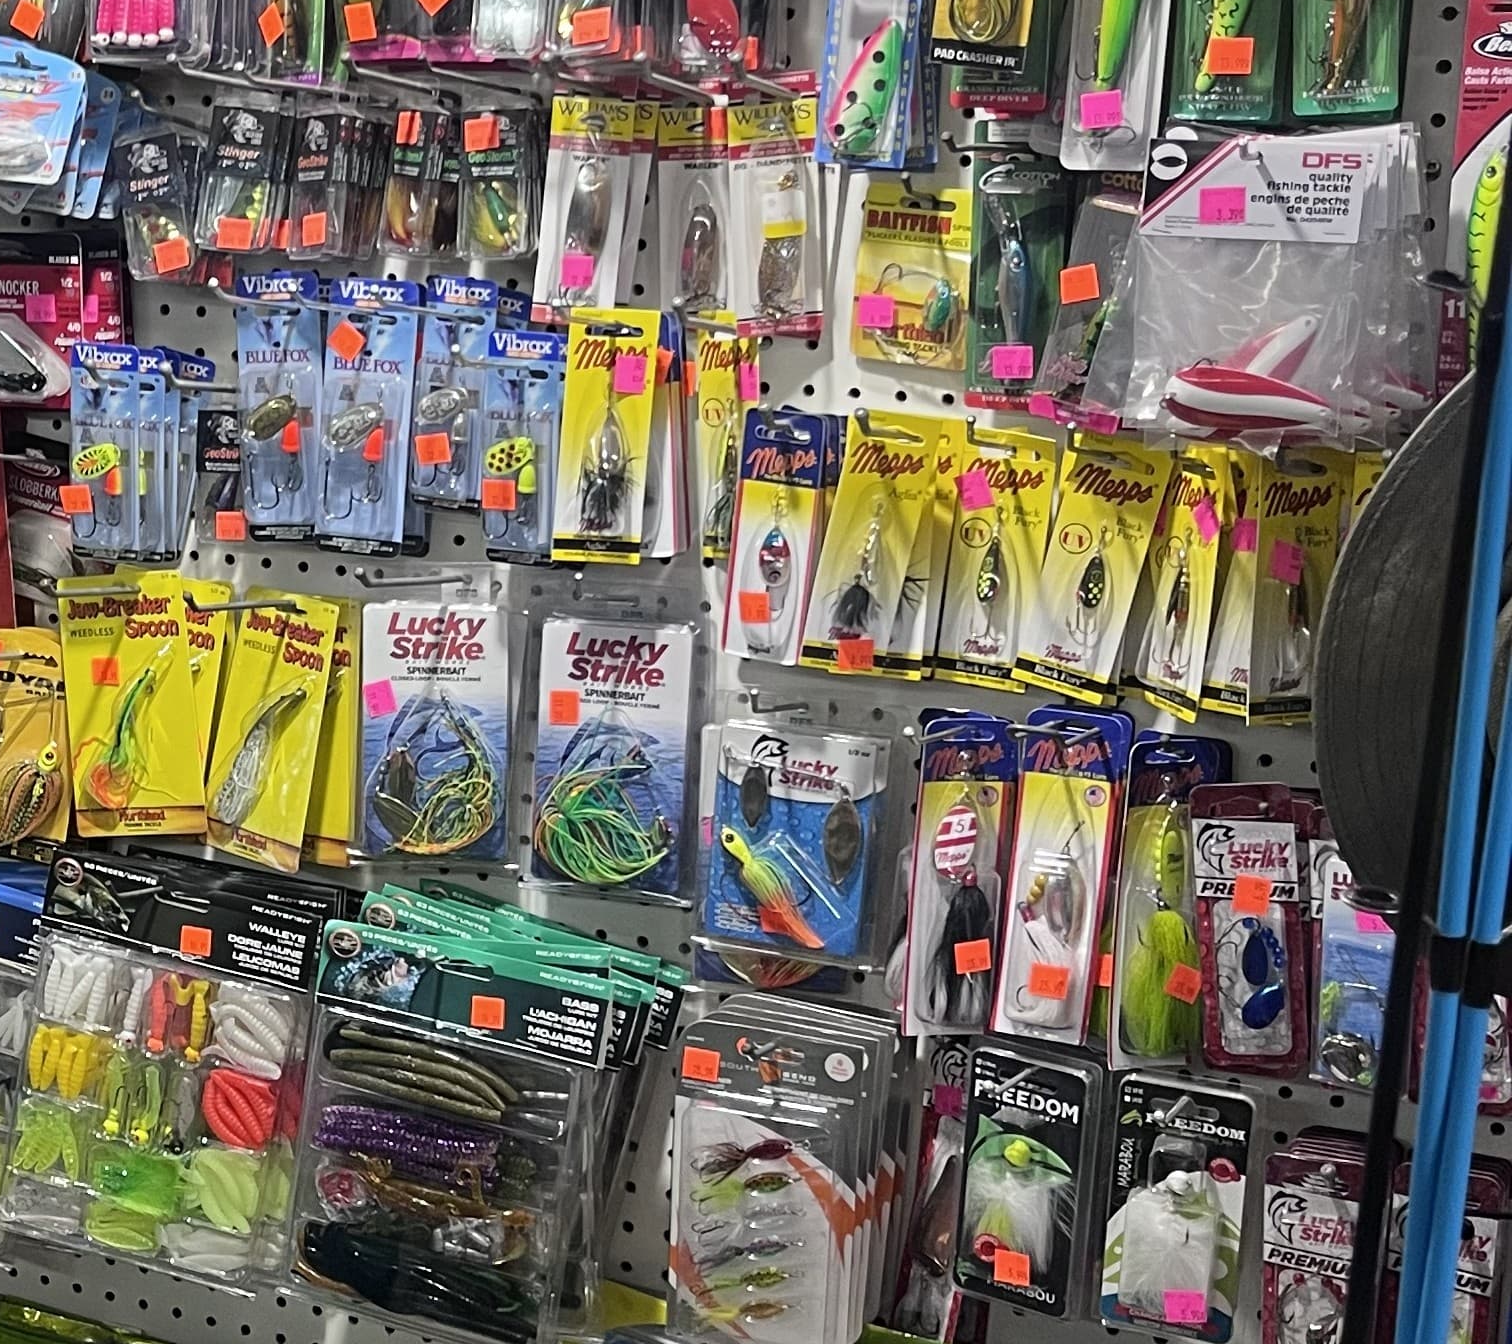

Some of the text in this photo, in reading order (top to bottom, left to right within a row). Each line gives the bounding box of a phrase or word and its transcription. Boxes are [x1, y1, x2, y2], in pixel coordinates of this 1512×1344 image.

[216, 144, 260, 160] Stinger
[1302, 152, 1362, 169] DFS
[128, 174, 170, 193] Stinger
[1268, 181, 1351, 192] fishing tackle
[1309, 173, 1353, 184] quality
[1251, 195, 1350, 207] engins de peche
[865, 211, 952, 234] BAITFISH
[61, 278, 73, 286] 1/2
[242, 276, 303, 294] Vibrax
[434, 280, 491, 300] Vibrax
[494, 333, 552, 354] Vibrax
[75, 346, 132, 366] Vibrax
[245, 349, 311, 363] BLUE FOX
[333, 356, 402, 372] BLUE FOX
[746, 447, 817, 475] Mepps
[851, 441, 926, 474] Mepps
[1073, 464, 1155, 502] Mepps
[1265, 483, 1334, 516] Mepps
[1063, 529, 1087, 550] UV
[68, 598, 171, 620] Jaw-Breaker
[70, 618, 180, 638] WEEDLESS Spoon
[388, 612, 488, 639] Lucky
[283, 644, 324, 672] Spoon
[390, 636, 485, 661] Strike
[566, 632, 668, 664] Lucky
[407, 666, 467, 676] SPINNERBAIT
[571, 658, 664, 687] Strike
[584, 688, 645, 701] SPINNERBAIT
[782, 757, 839, 776] Lucky
[779, 771, 835, 790] Strike
[1227, 840, 1289, 858] Lucky
[1230, 855, 1288, 870] Strike
[248, 921, 306, 944] WALLEYE
[562, 997, 599, 1012] BASS
[527, 1024, 593, 1052] MOJARRA
[974, 1080, 1080, 1124] FREEDOM
[1145, 1111, 1246, 1141] FREEDOM
